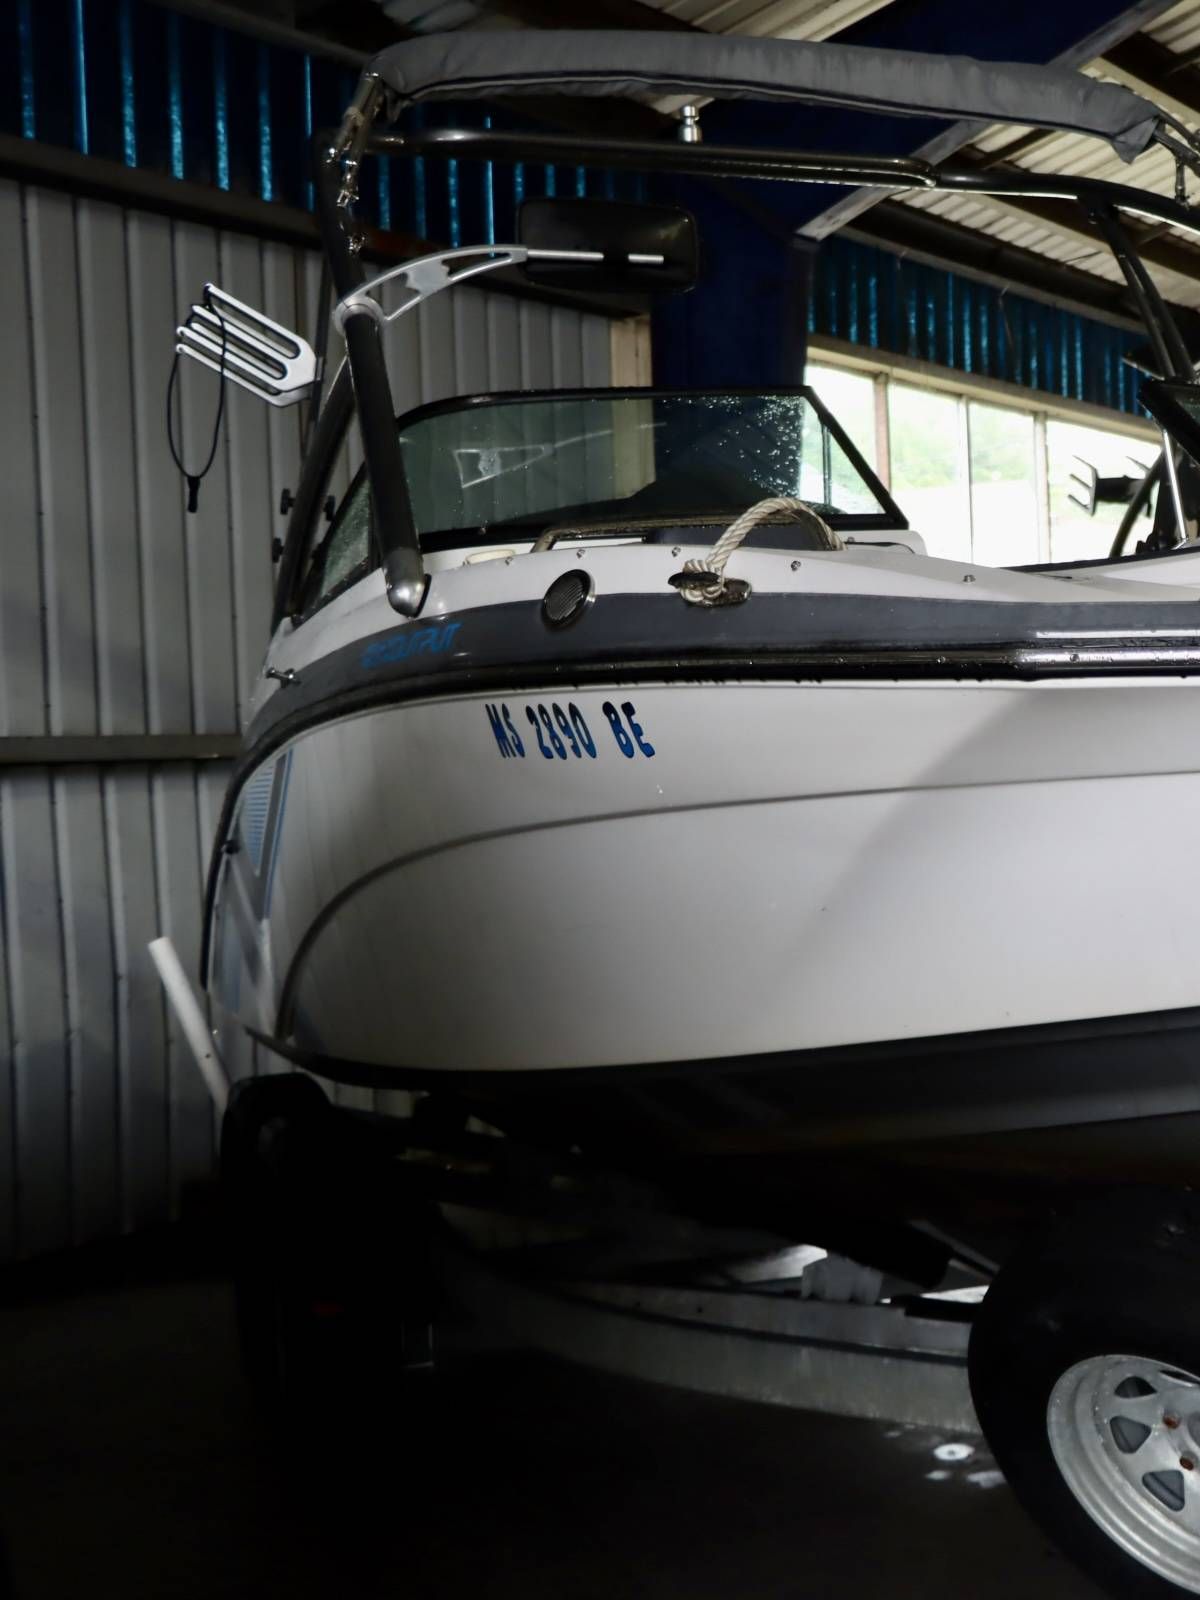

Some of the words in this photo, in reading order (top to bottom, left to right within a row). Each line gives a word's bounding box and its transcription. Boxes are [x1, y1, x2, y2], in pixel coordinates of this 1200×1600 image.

[484, 702, 526, 759] MS
[525, 701, 597, 761] 2890
[601, 700, 656, 759] BE
